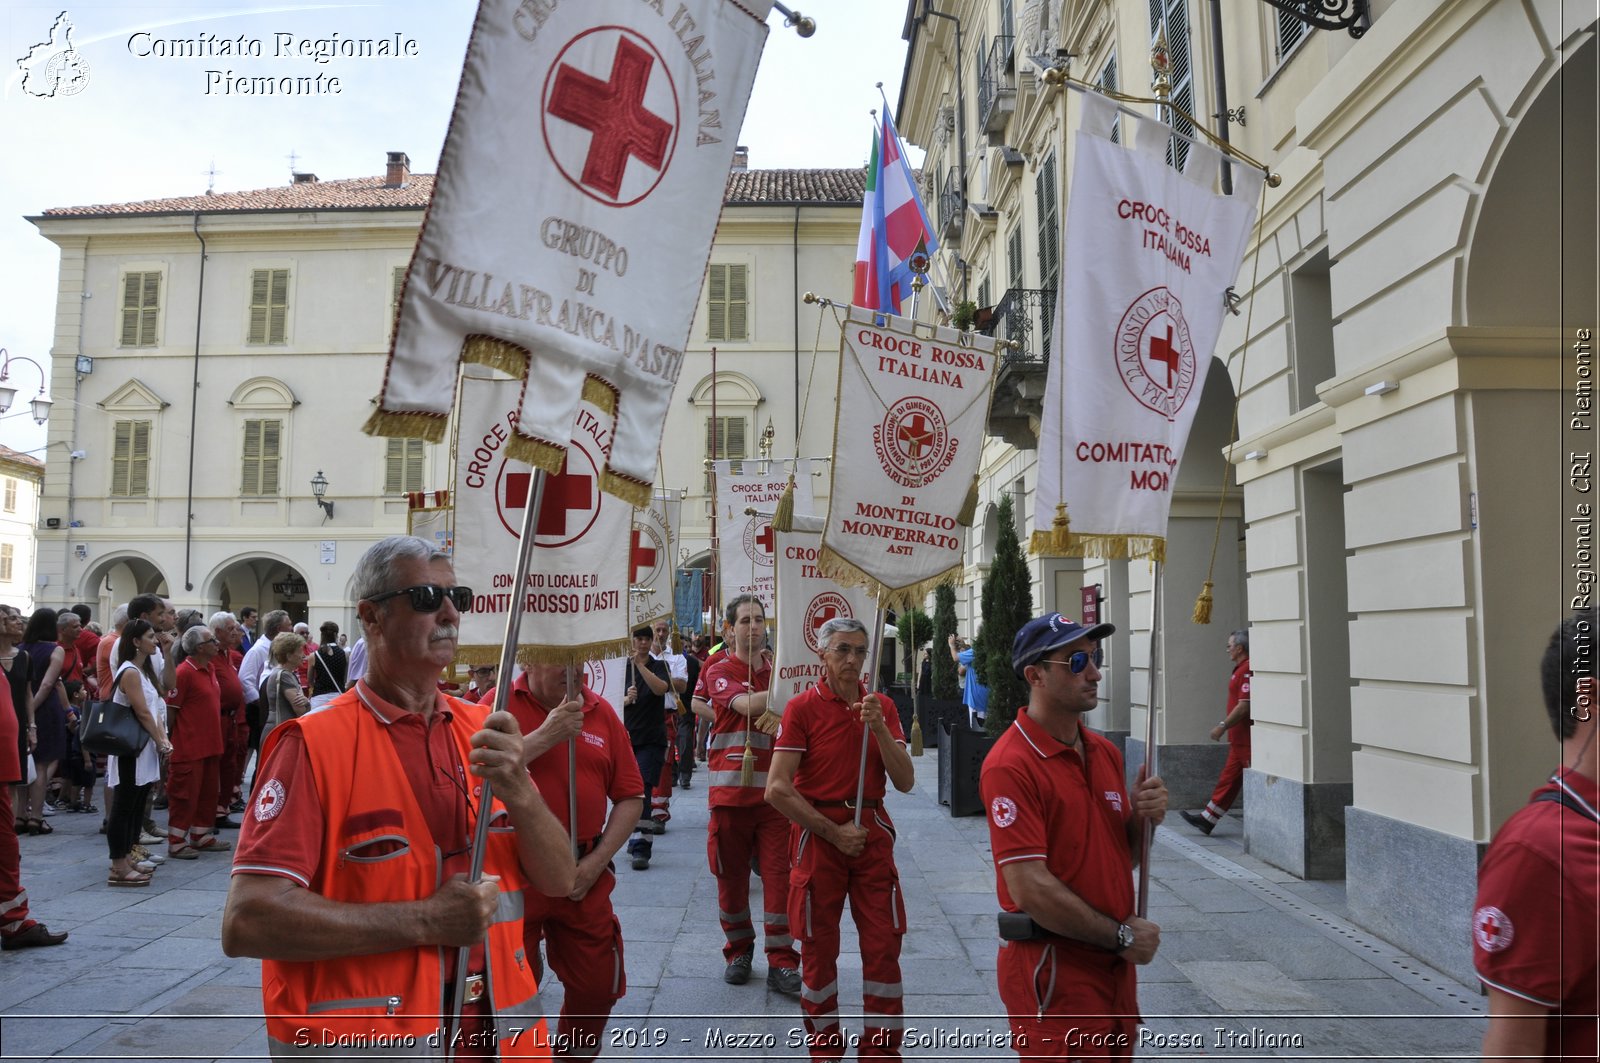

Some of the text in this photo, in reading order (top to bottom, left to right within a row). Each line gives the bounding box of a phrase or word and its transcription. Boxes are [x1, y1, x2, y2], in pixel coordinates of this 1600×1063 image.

[668, 3, 723, 148] ITALIANA
[1117, 199, 1212, 258] CROCE ROSSA
[540, 216, 628, 277] GRUPPO
[1143, 229, 1192, 275] ITALIANA
[575, 267, 598, 296] DI
[426, 257, 684, 384] VILLAFRANCA D'ASTI
[1120, 306, 1150, 363] AGOSTO
[858, 329, 986, 371] CROCE ROSSA
[878, 355, 964, 389] ITALIANA
[896, 405, 906, 415] DI
[905, 401, 936, 418] GINEVRA
[933, 414, 941, 425] 22
[466, 423, 508, 489] CROCE
[873, 423, 903, 486] VOLONTARI
[923, 437, 960, 486] SOCCORSO
[1076, 441, 1173, 465] COMITATO
[731, 484, 763, 493] CROCE
[744, 493, 780, 503] ITALIAN
[901, 495, 916, 506] DI
[855, 502, 956, 531] MONTIGLIO
[842, 519, 959, 551] MONFERRATO
[886, 543, 914, 556] ASTI
[493, 574, 598, 588] COMATO LOCALE DI
[583, 590, 619, 613] D'ASTI
[779, 664, 827, 679] COMITATO
[793, 681, 801, 695] DI
